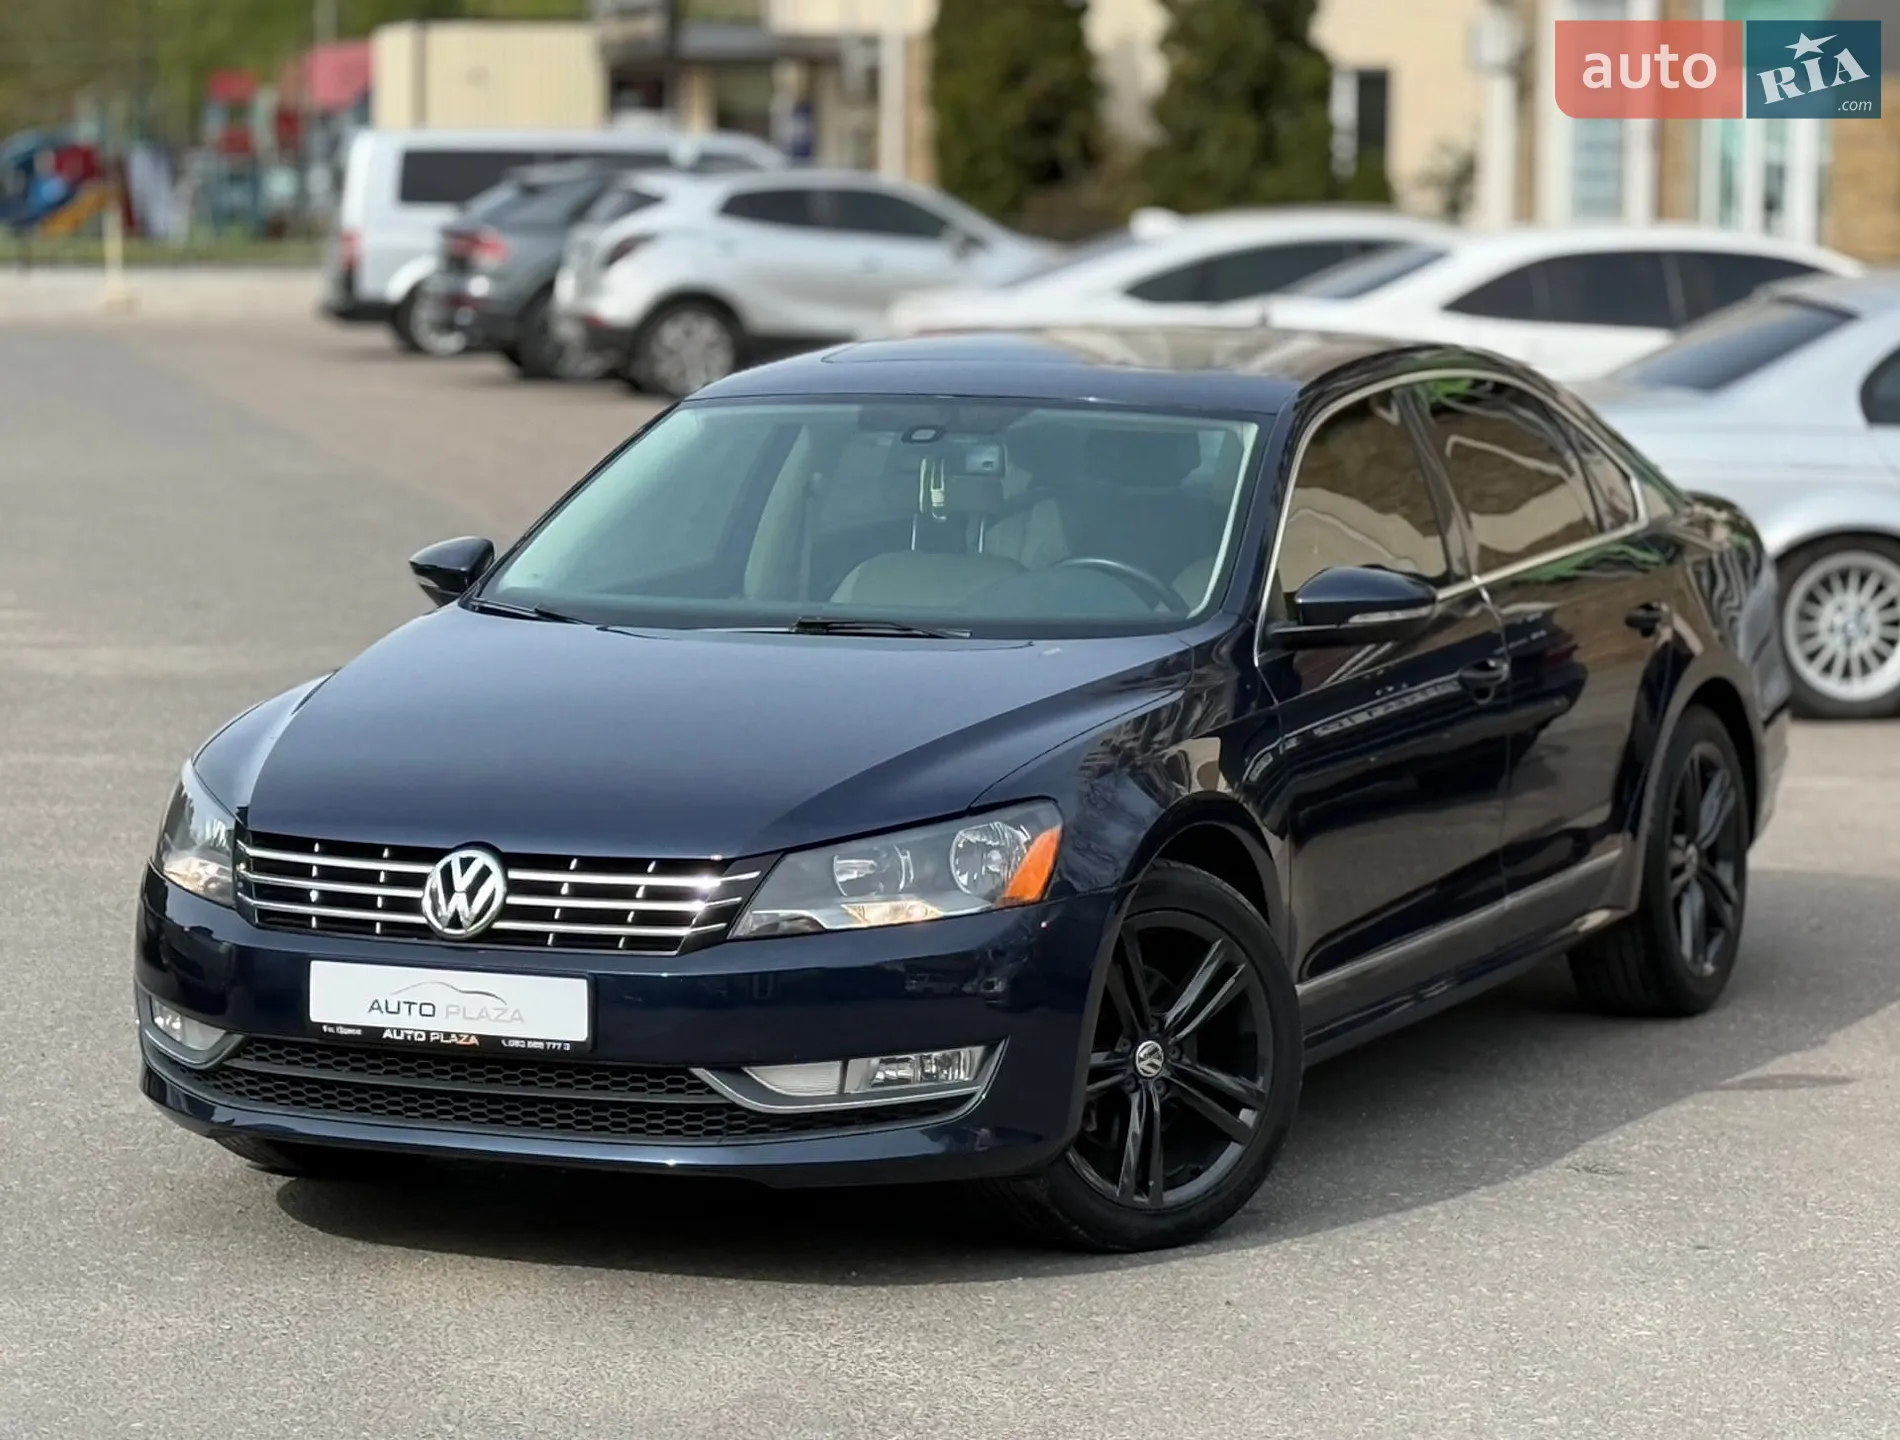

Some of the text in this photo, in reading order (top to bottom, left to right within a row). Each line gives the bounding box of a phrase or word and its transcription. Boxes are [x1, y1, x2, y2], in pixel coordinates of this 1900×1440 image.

[368, 998, 526, 1025] AUTO PLAZA
[382, 1028, 480, 1047] AUTO PLAZA
